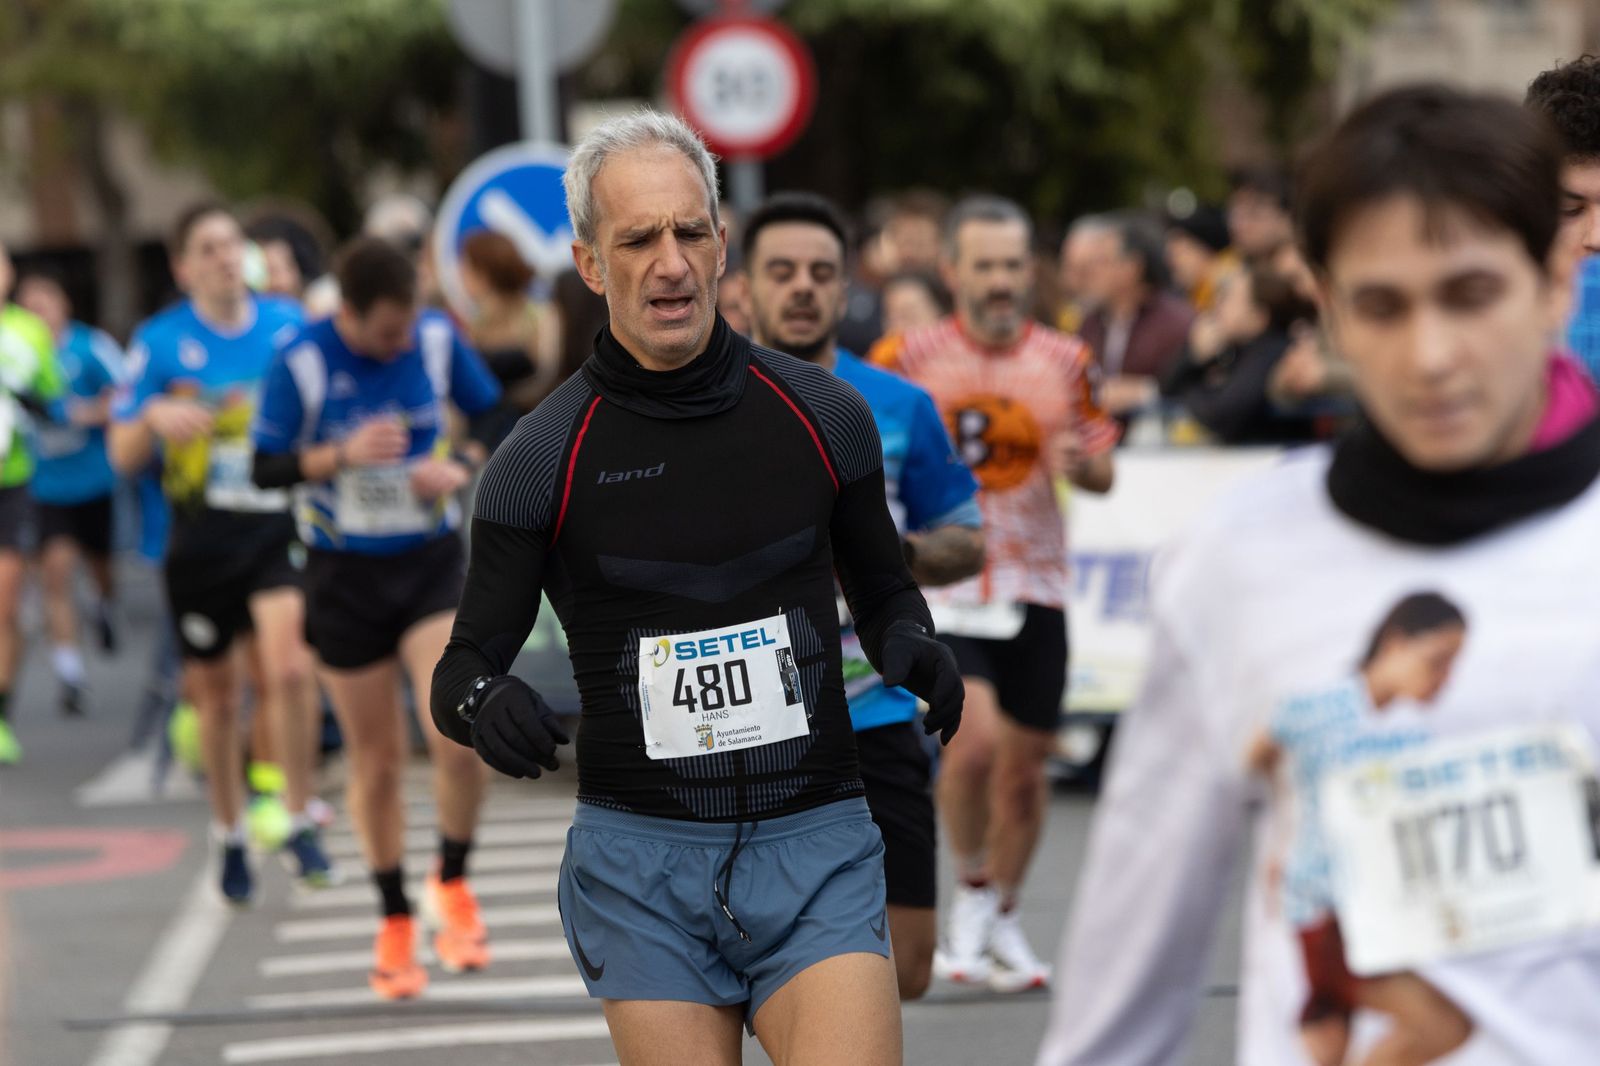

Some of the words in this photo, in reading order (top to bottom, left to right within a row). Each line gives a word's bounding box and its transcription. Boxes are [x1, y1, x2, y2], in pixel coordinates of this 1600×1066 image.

[597, 462, 665, 484] land
[674, 627, 776, 661] SETEL
[673, 659, 752, 713] 480
[701, 709, 730, 721] HANS
[716, 725, 761, 738] Ayuntamiento
[728, 735, 762, 746] Salamanca
